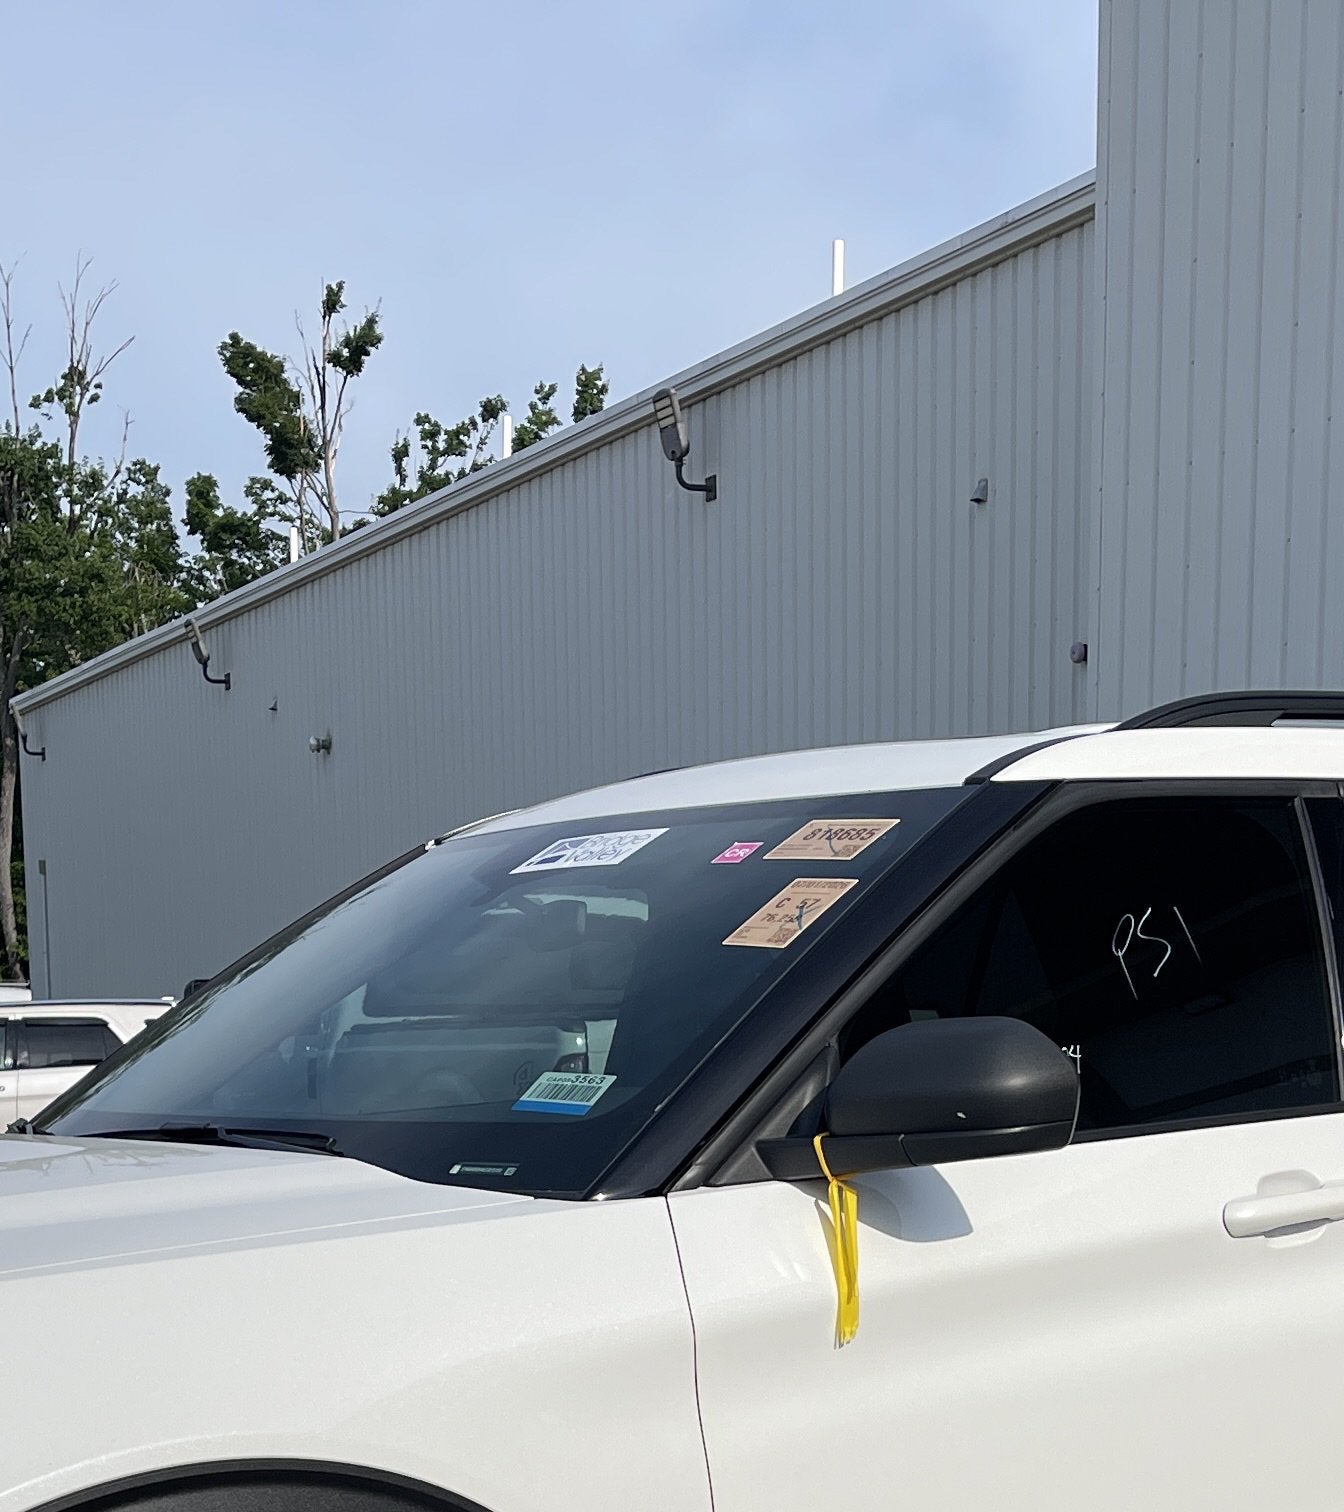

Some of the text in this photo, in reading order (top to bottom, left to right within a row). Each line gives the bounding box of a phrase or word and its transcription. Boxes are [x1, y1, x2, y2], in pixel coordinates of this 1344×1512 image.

[803, 828, 882, 841] 818685
[775, 897, 822, 909] C 57
